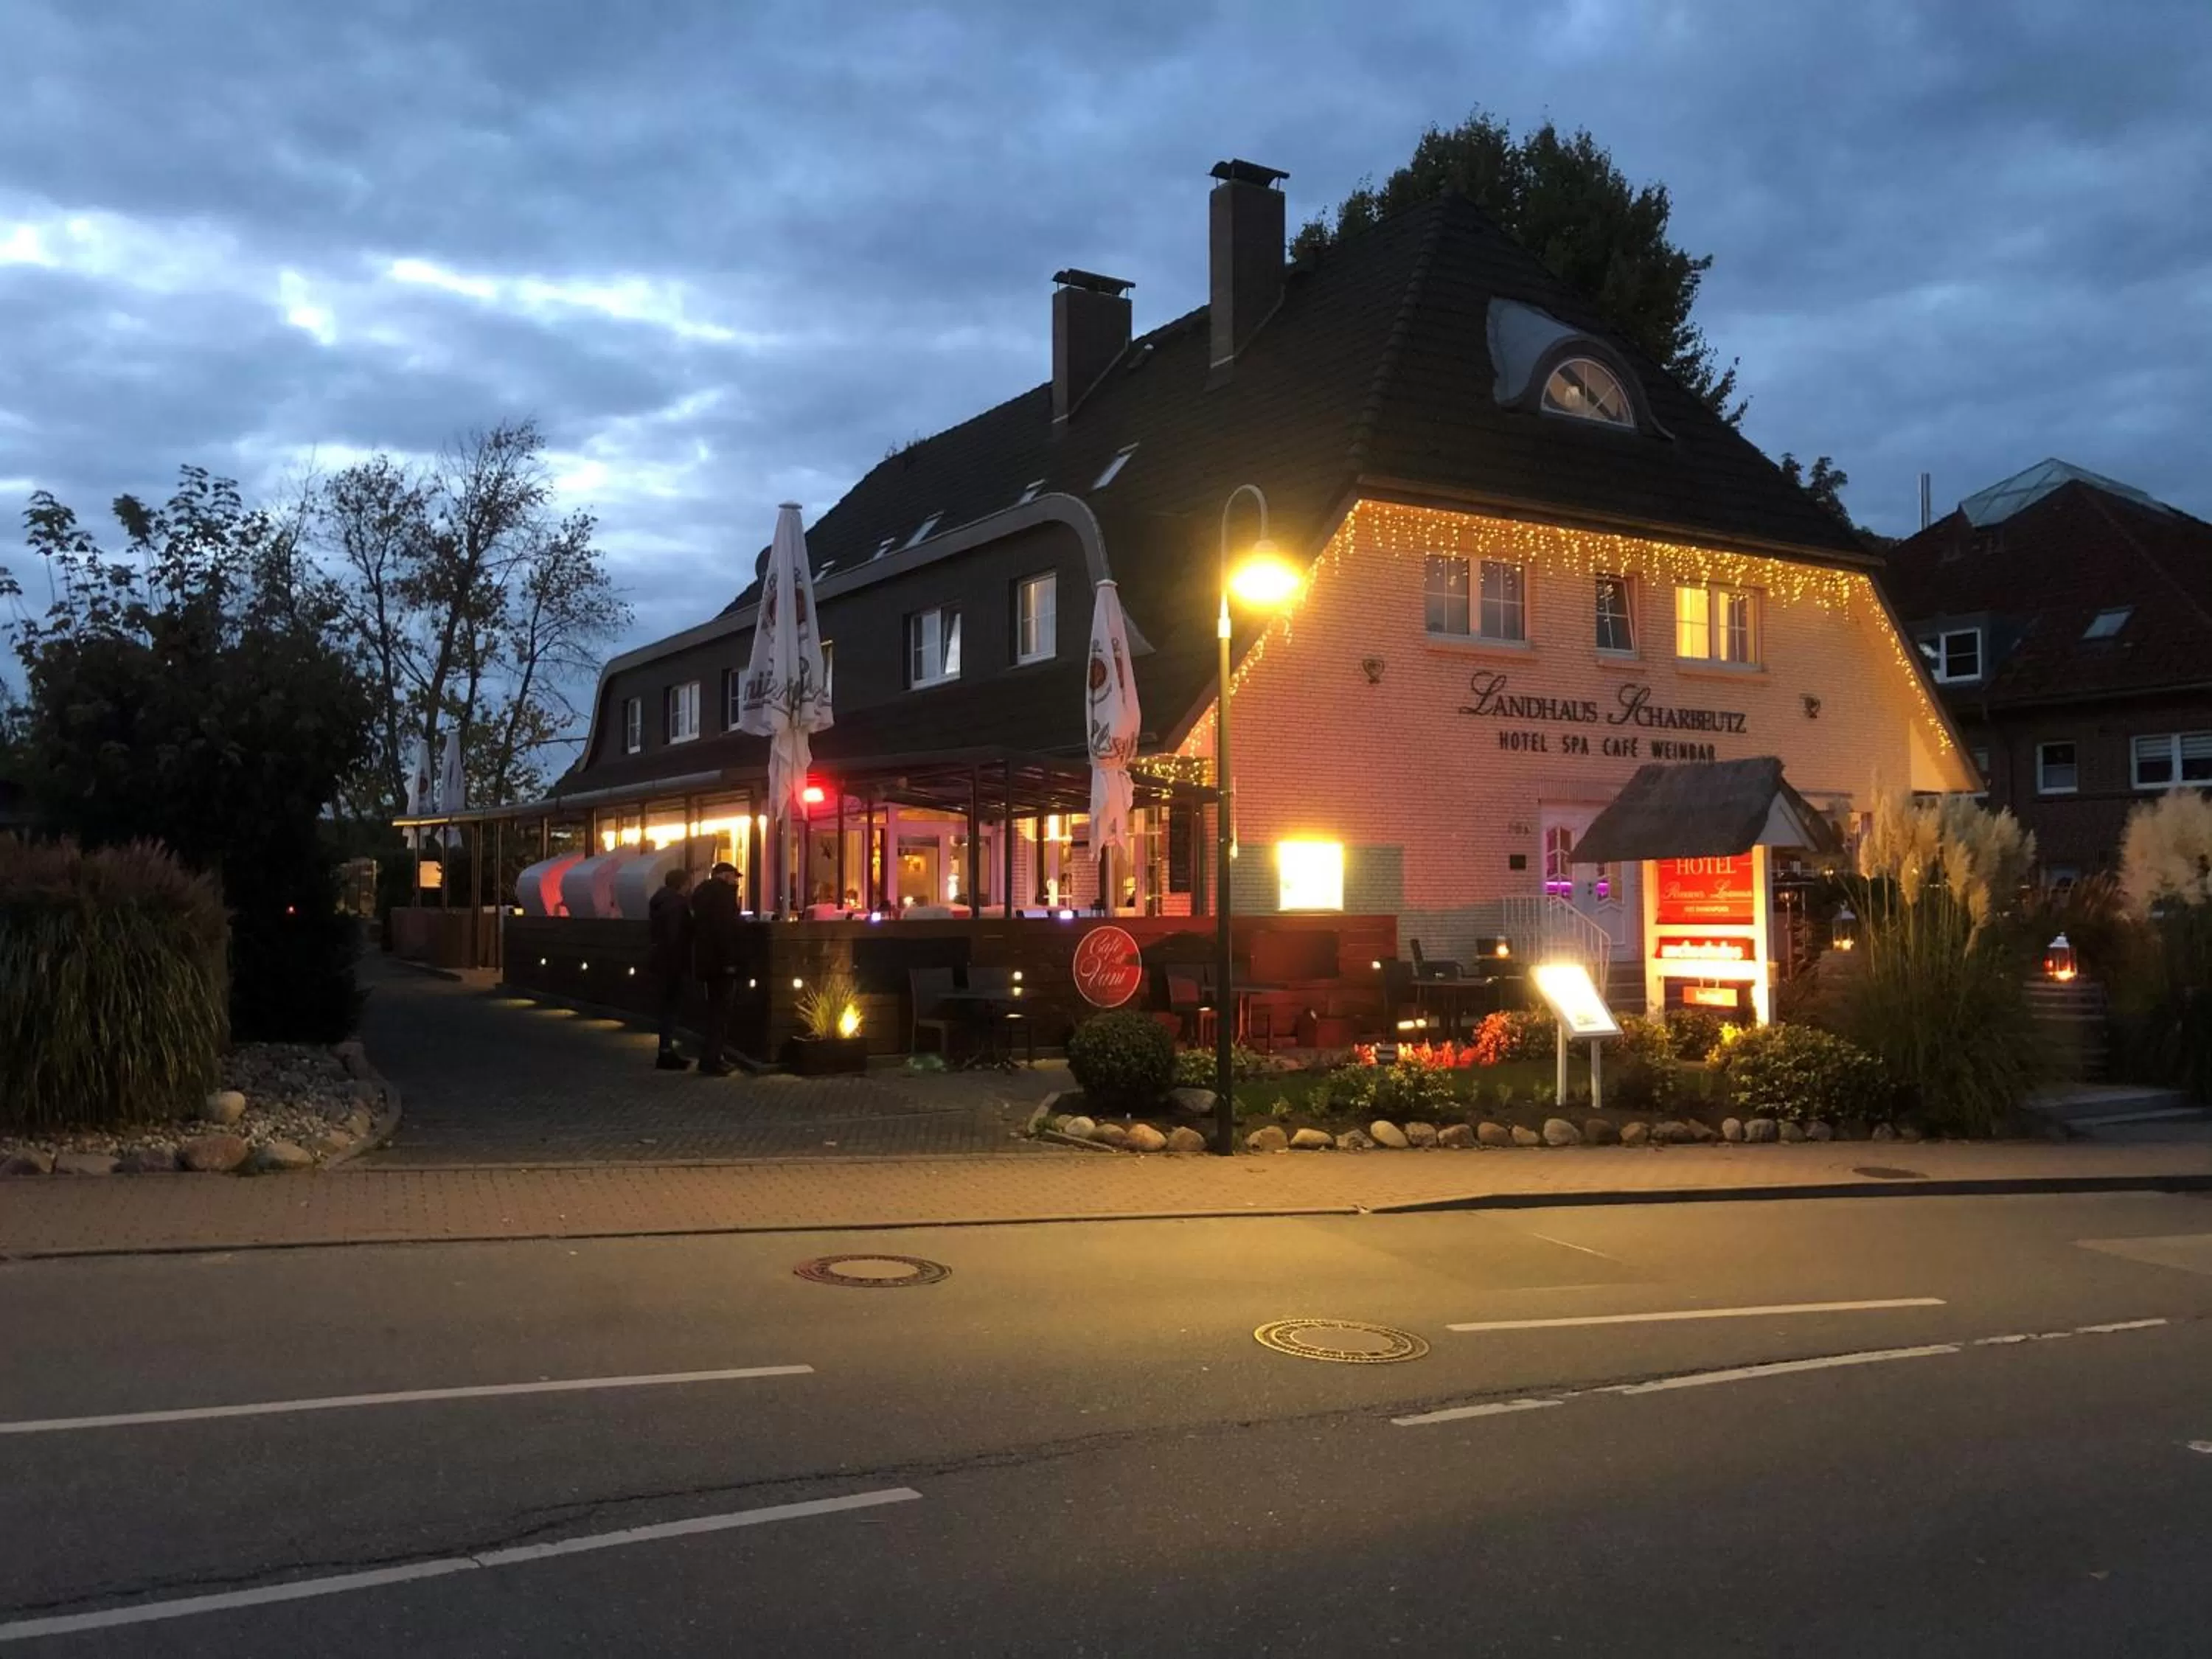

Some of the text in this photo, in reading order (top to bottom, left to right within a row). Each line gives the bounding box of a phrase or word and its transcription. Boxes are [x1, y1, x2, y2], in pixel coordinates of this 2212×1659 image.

[1458, 671, 1598, 724] LANDHAUS
[1500, 732, 1715, 762] HOTEL SPA CAFÉ WEINBAR
[1676, 856, 1736, 875] HOTEL
